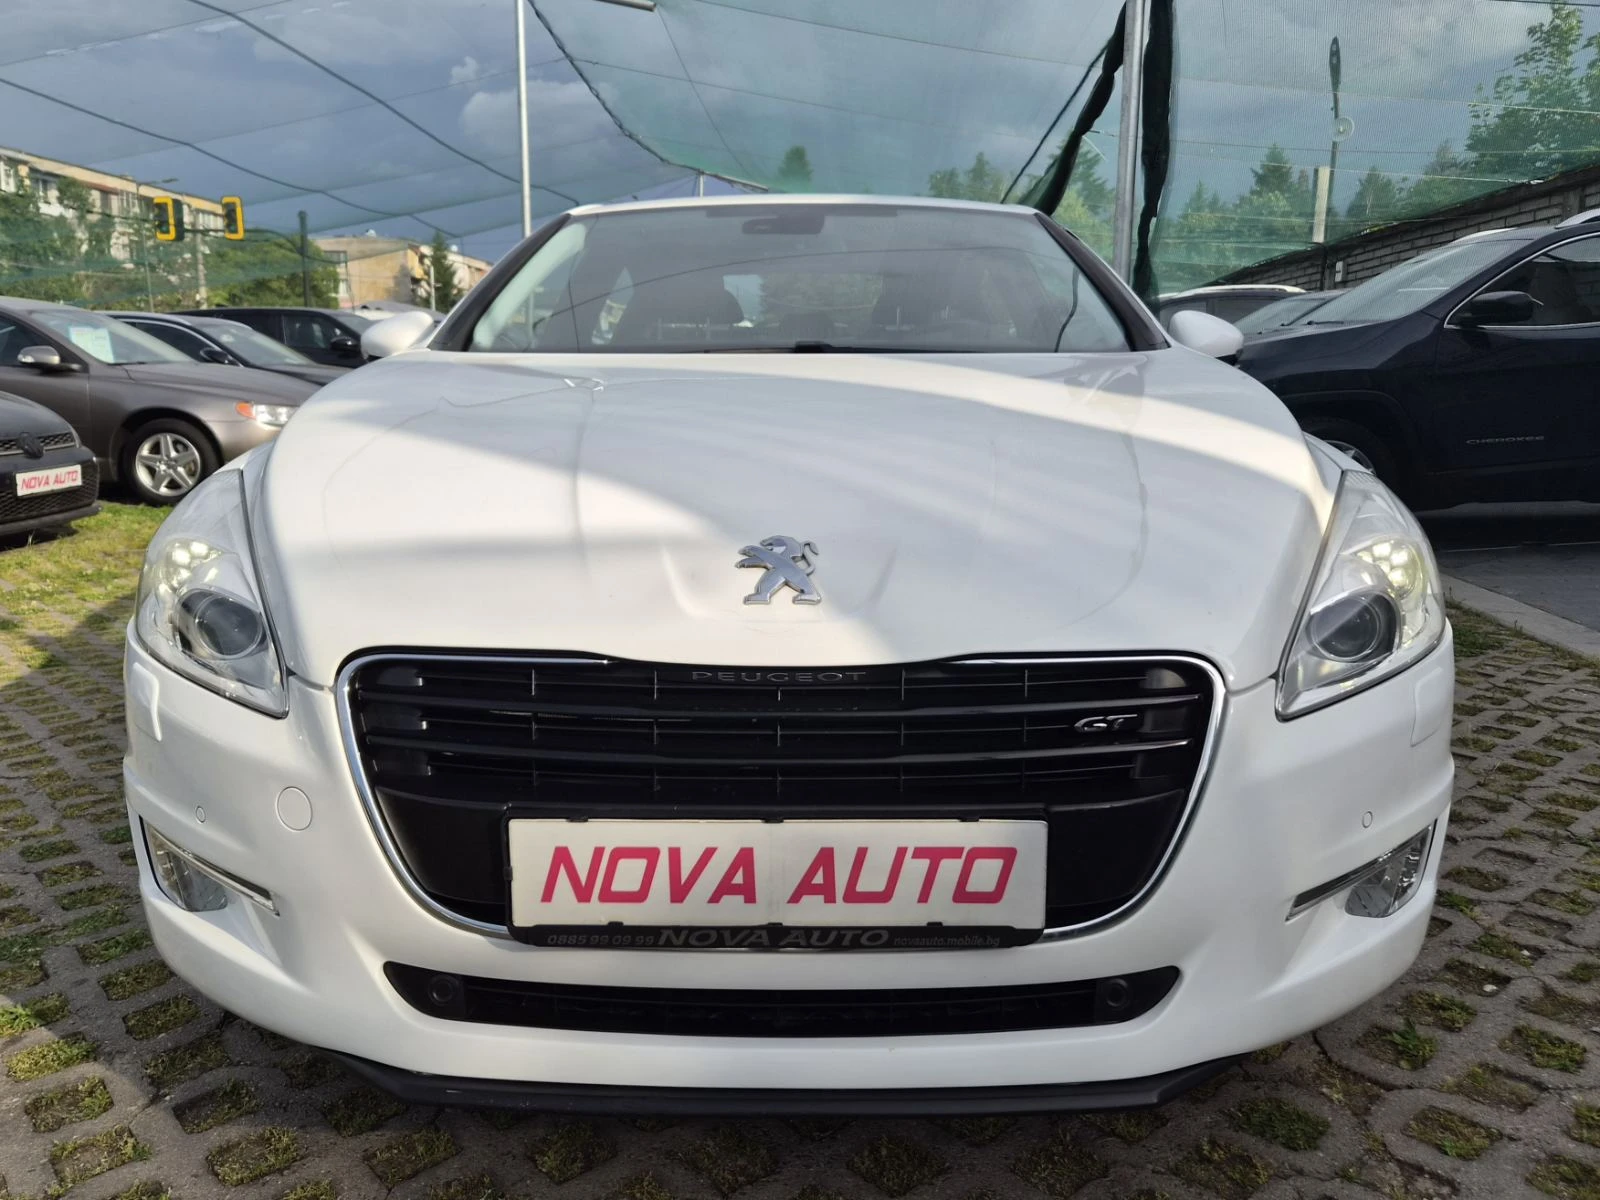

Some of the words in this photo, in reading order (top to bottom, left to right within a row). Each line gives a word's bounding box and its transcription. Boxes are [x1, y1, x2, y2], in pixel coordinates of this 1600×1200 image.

[1465, 435, 1545, 444] CHEROKEE
[21, 475, 50, 489] NOVA
[53, 470, 79, 485] AUTO
[691, 671, 867, 682] PEUGEOT
[1074, 714, 1138, 732] GT
[540, 846, 757, 904] NOVA
[786, 846, 1018, 904] AUTO
[547, 934, 587, 946] 0885
[589, 935, 609, 946] 99
[611, 935, 633, 946] 09
[634, 936, 655, 947] 99
[657, 928, 771, 947] NOVA
[778, 929, 889, 947] AUTO
[893, 936, 1000, 948] novaauto.mobile.bg
